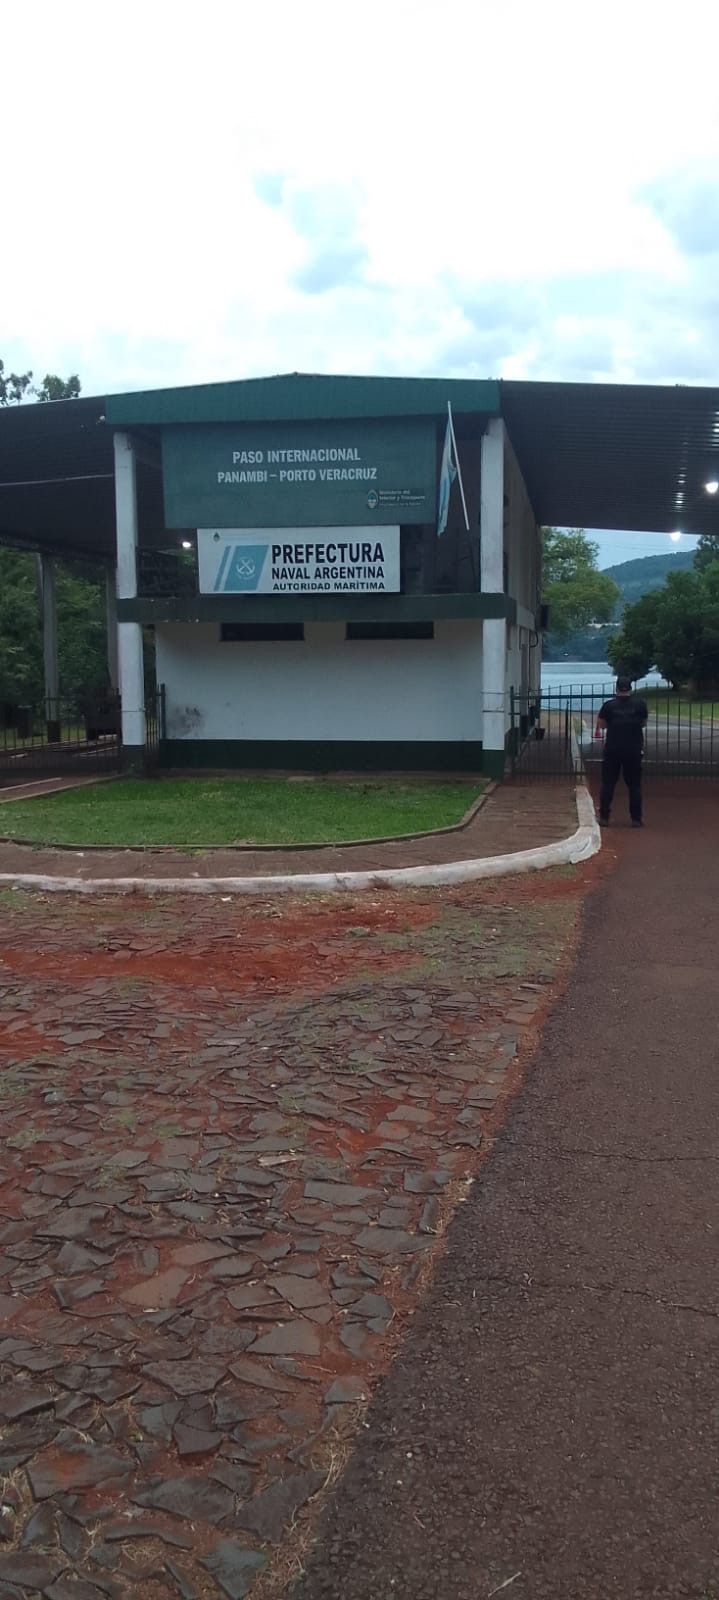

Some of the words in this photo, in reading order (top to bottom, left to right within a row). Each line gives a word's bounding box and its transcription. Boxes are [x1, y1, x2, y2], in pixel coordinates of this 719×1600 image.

[233, 451, 263, 464] PASO
[267, 448, 361, 463] INTERNACIONAL
[217, 470, 267, 483] PANAMBI
[279, 469, 316, 482] PORTO
[319, 467, 378, 481] VERACRUZ
[271, 542, 385, 564] PREFECTURA
[271, 567, 310, 580] NAVAL
[314, 565, 385, 580] ARGENTINA
[272, 582, 331, 591] AUTORIDAD
[333, 581, 385, 590] MARÍTIMA
